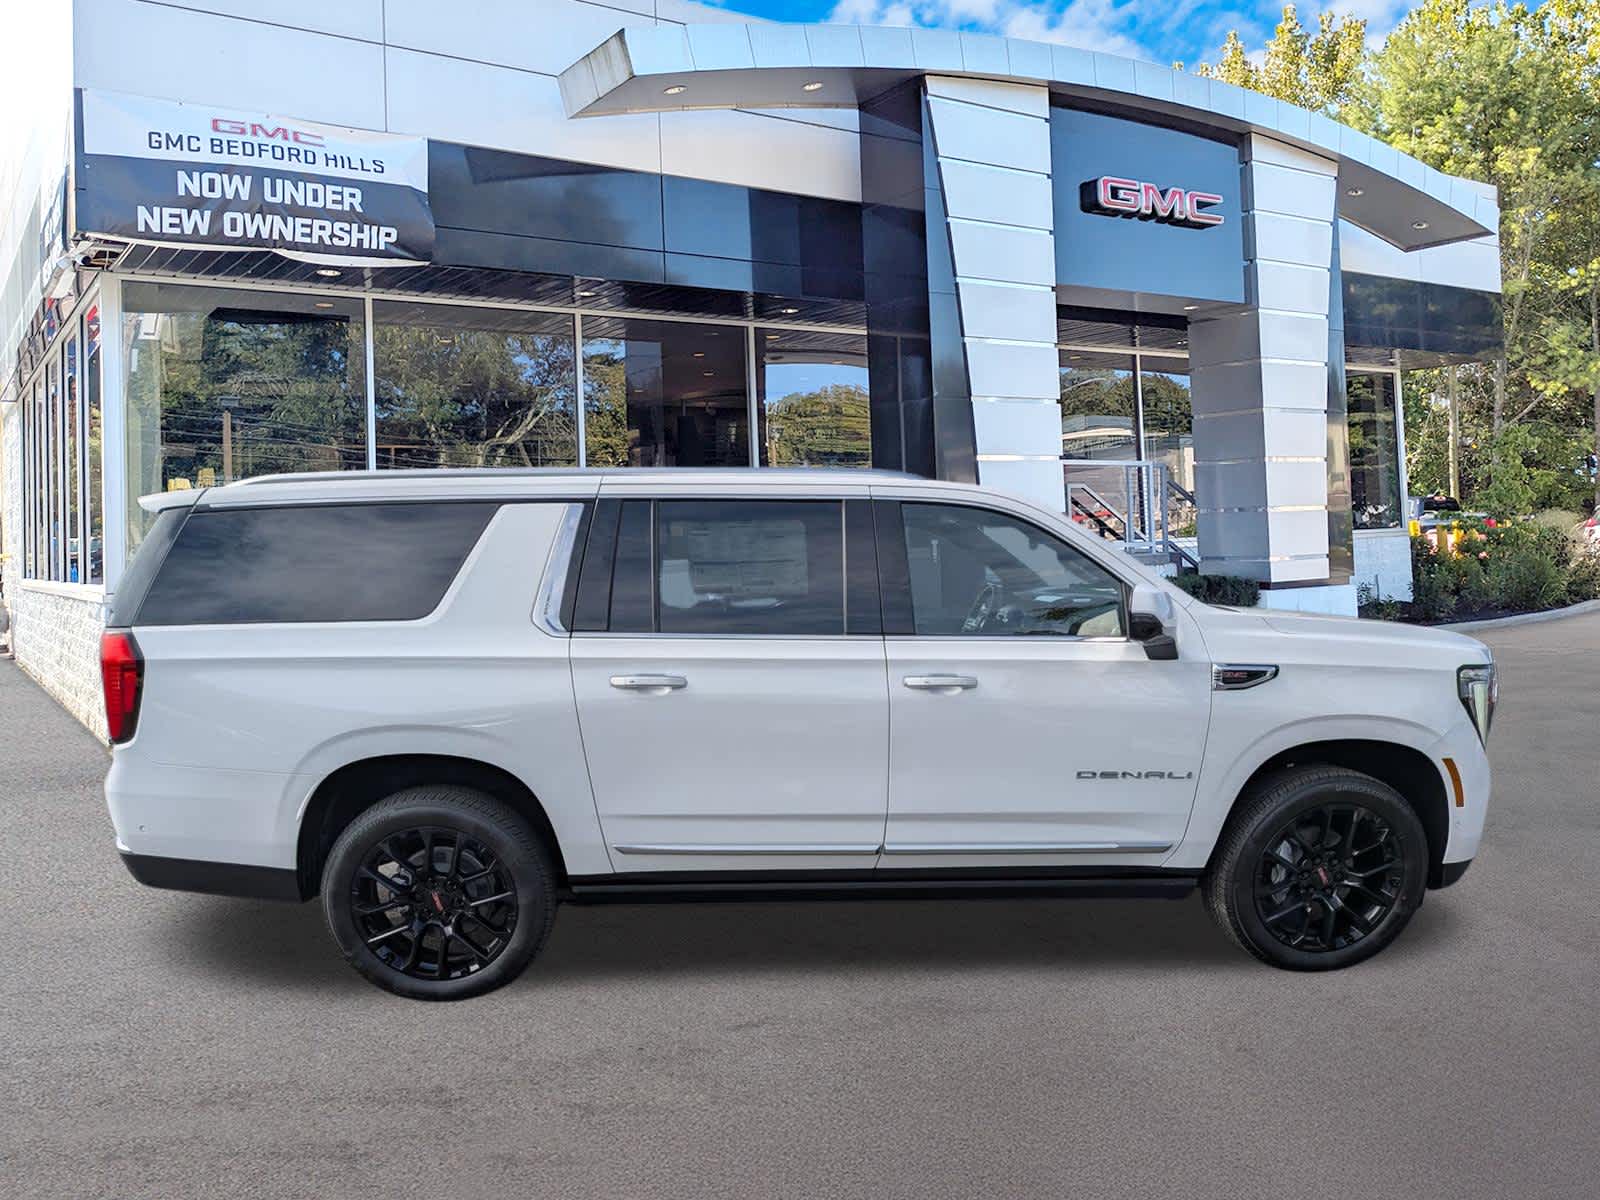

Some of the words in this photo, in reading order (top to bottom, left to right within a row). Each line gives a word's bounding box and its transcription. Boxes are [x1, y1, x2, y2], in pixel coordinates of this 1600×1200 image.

[148, 131, 201, 152] GMC
[210, 138, 317, 165] BEDFORD
[324, 154, 385, 174] HILLS
[211, 118, 325, 147] GMC
[176, 170, 252, 201] NOW
[263, 176, 364, 213] UNDER
[1097, 175, 1225, 225] GMC
[136, 206, 212, 236] NEW
[223, 211, 398, 250] OWNERSHIP
[1076, 771, 1193, 780] DENALI
